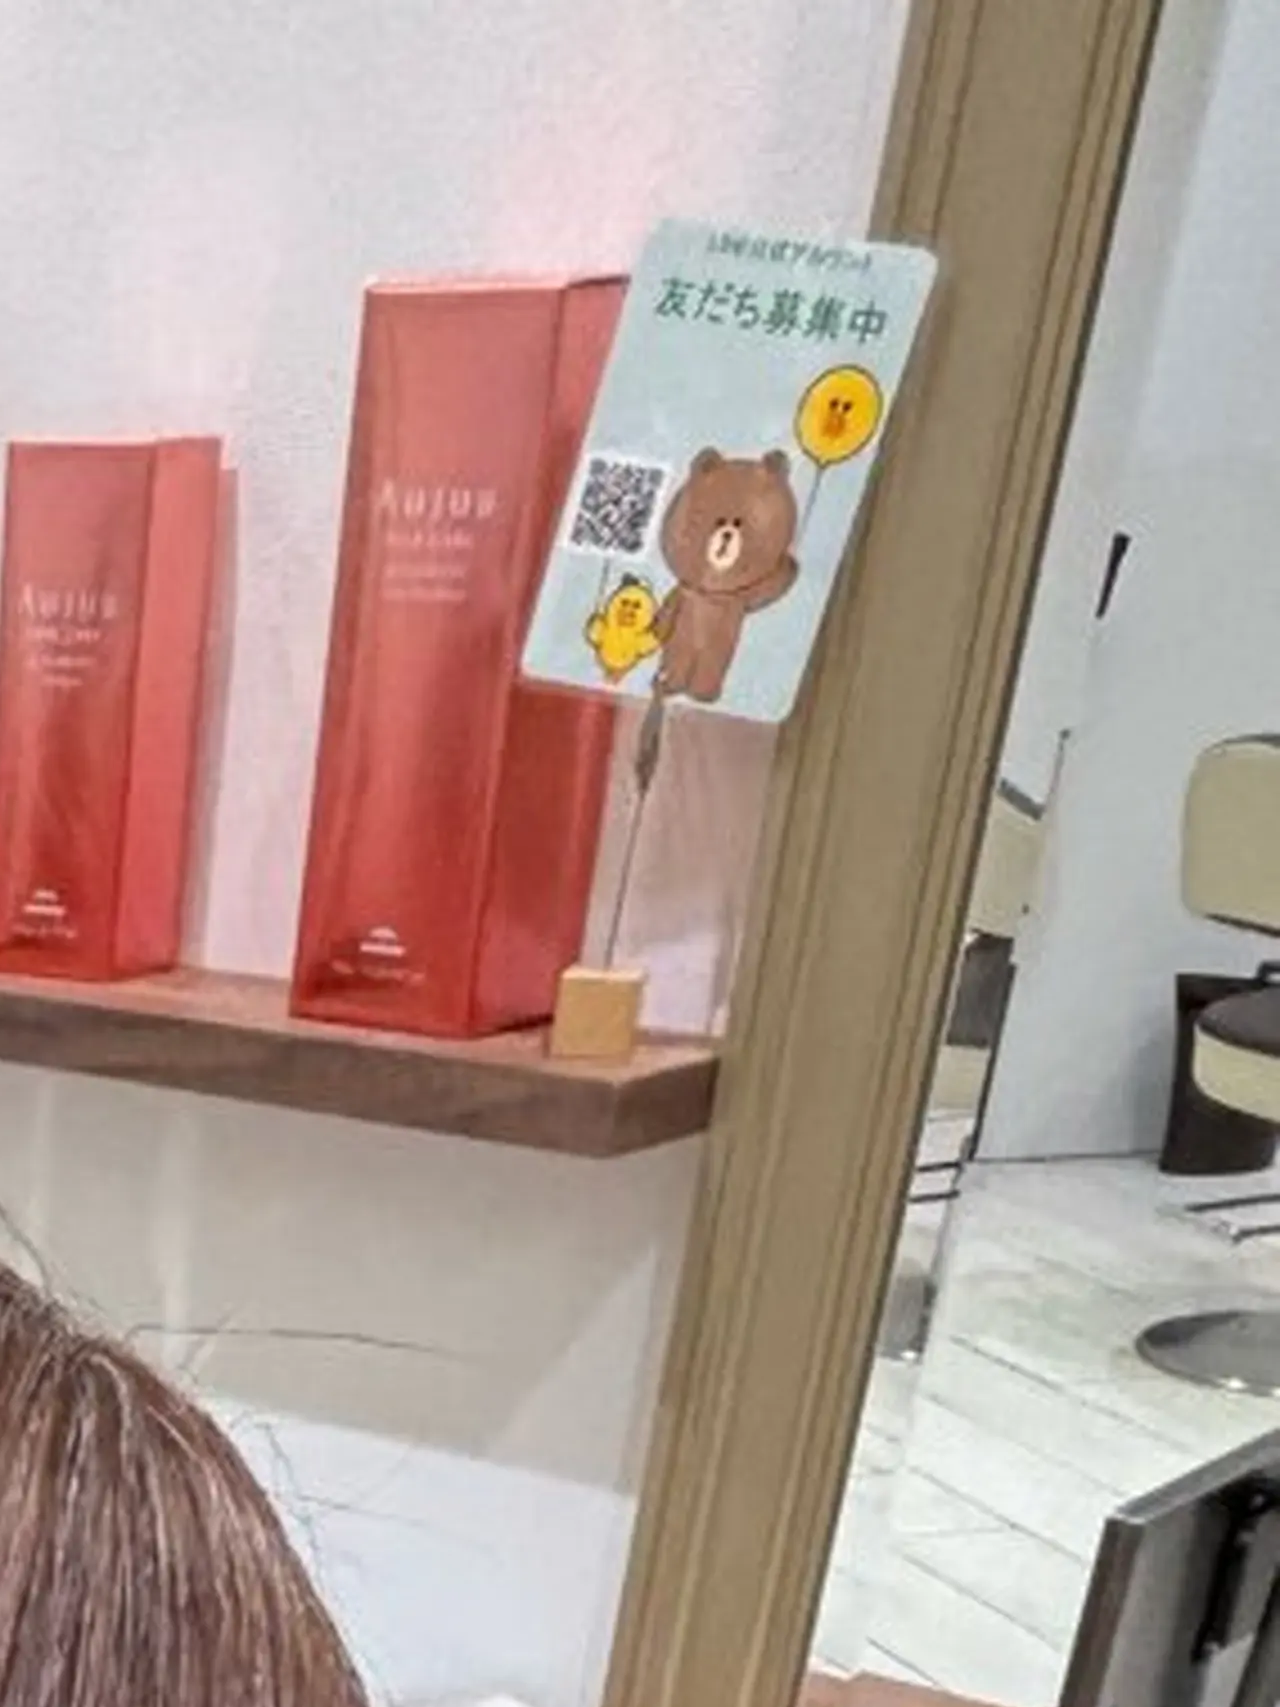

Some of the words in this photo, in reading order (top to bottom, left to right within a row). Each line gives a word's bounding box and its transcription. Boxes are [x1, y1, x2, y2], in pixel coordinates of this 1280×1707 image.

[654, 276, 888, 344] 友だち募集中
